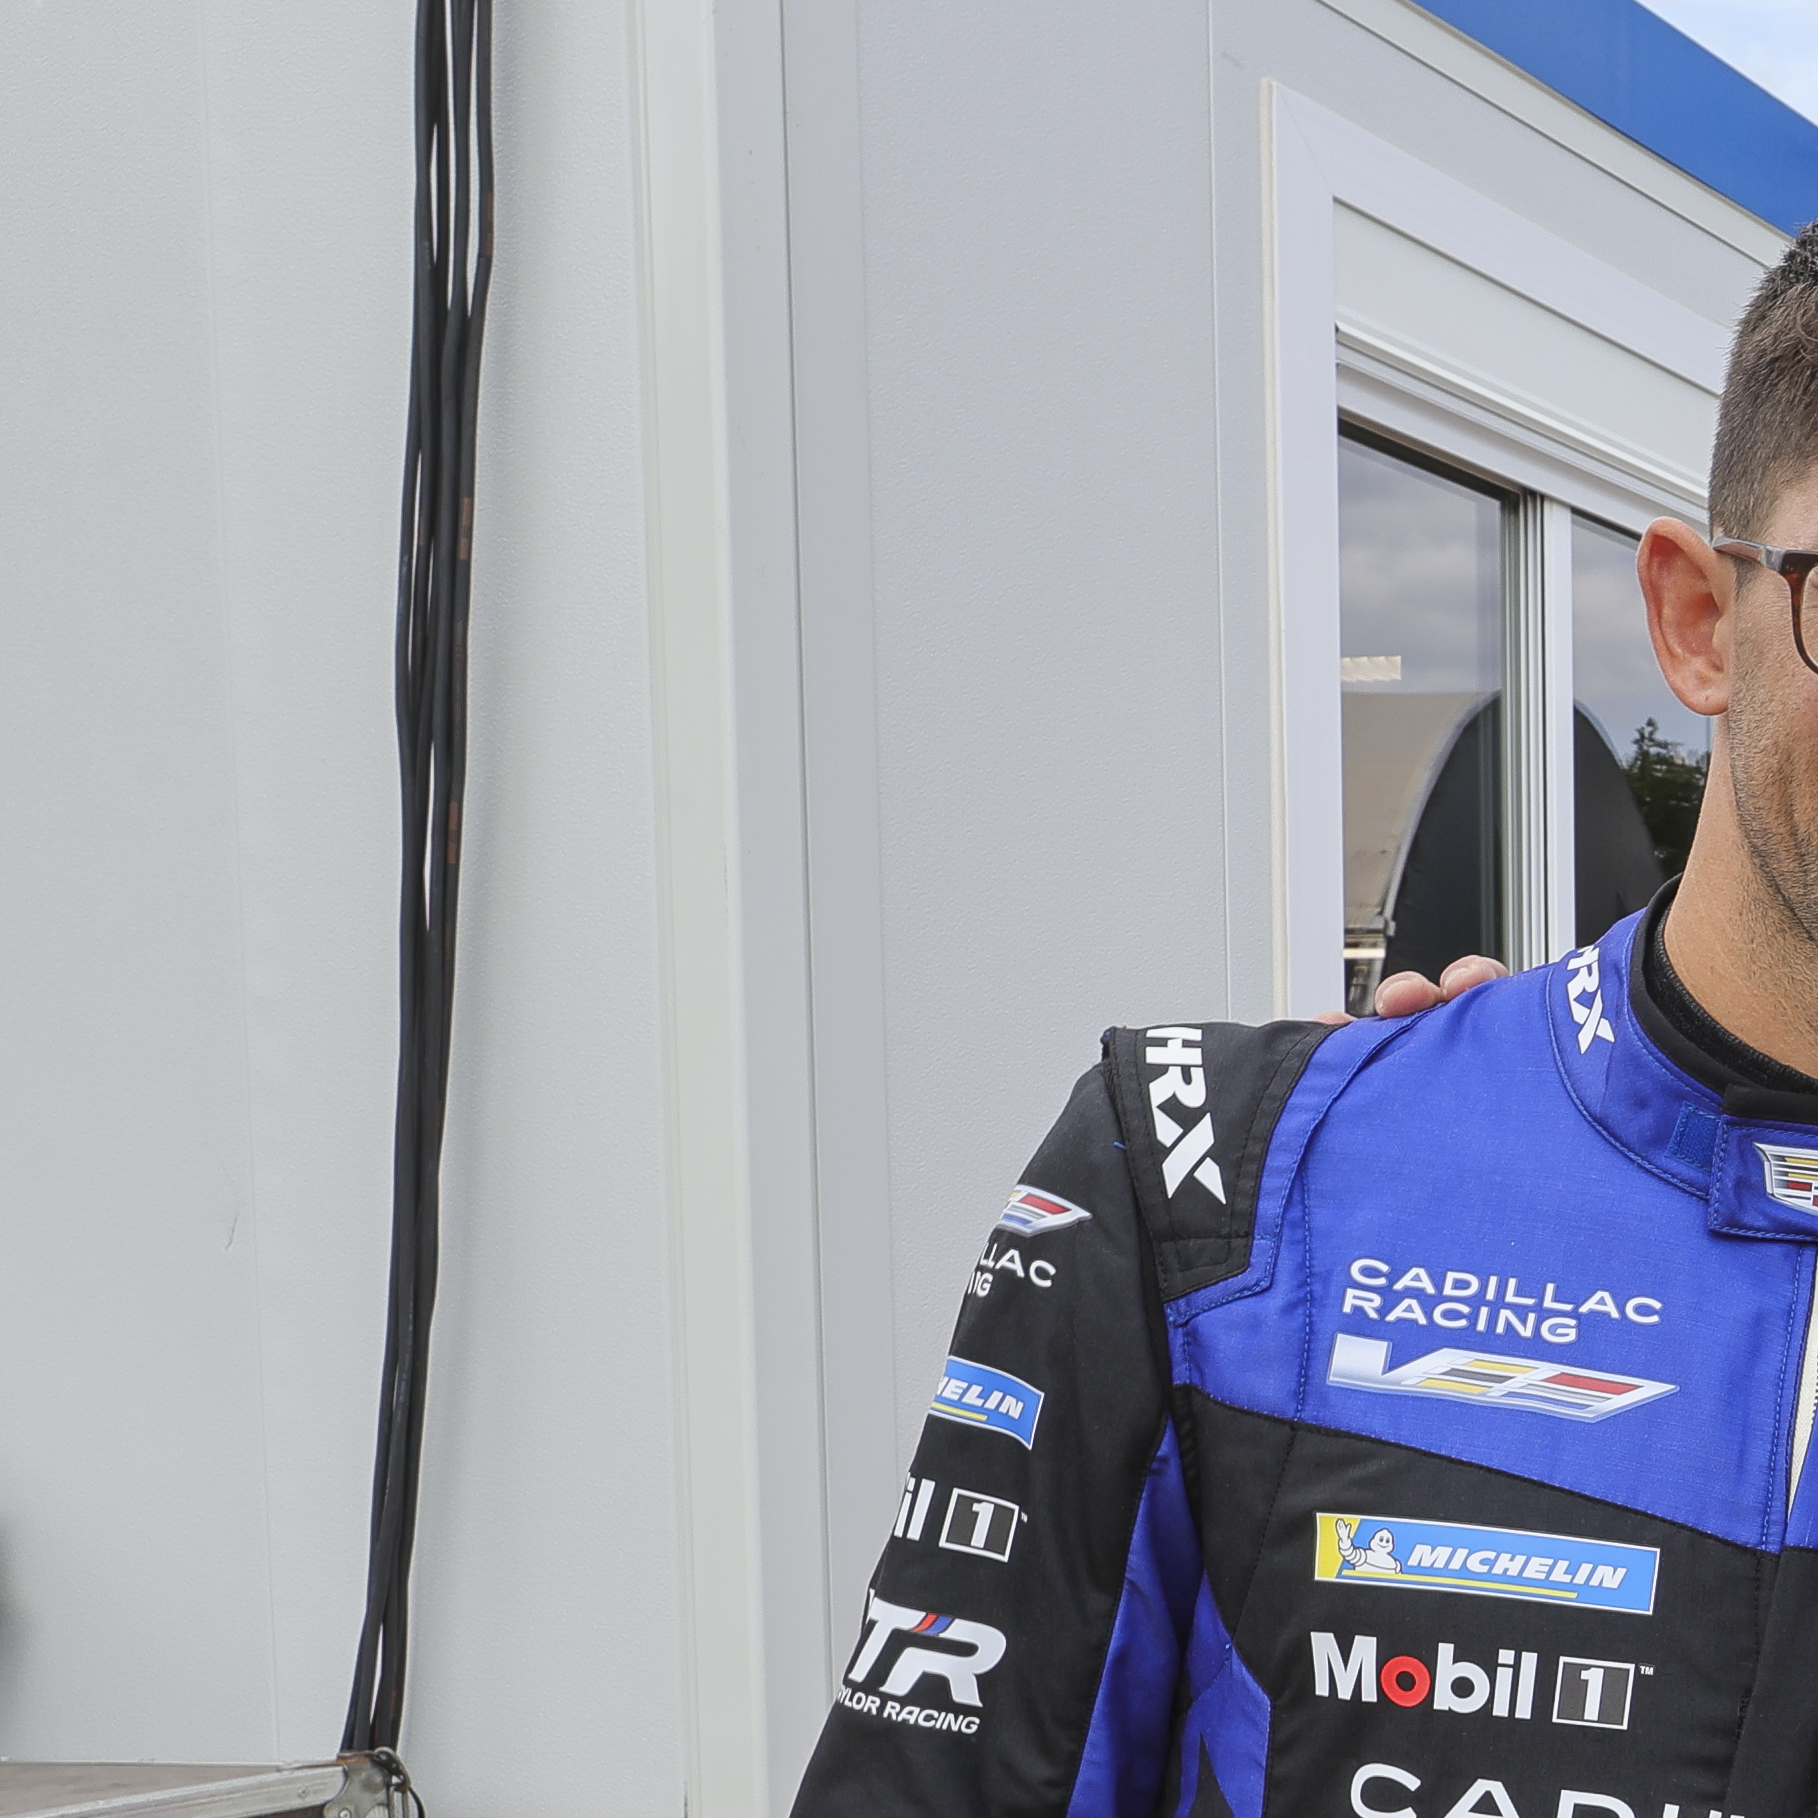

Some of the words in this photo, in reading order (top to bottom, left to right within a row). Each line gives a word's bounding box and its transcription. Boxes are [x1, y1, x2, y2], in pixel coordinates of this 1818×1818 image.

[1143, 1021, 1227, 1205] HRX
[1342, 1287, 1578, 1345] RACING
[1350, 1258, 1662, 1325] CADILLAC
[1407, 1544, 1628, 1590] MICHELIN
[1310, 1631, 1538, 1720] Mobil
[882, 1697, 983, 1734] RACING
